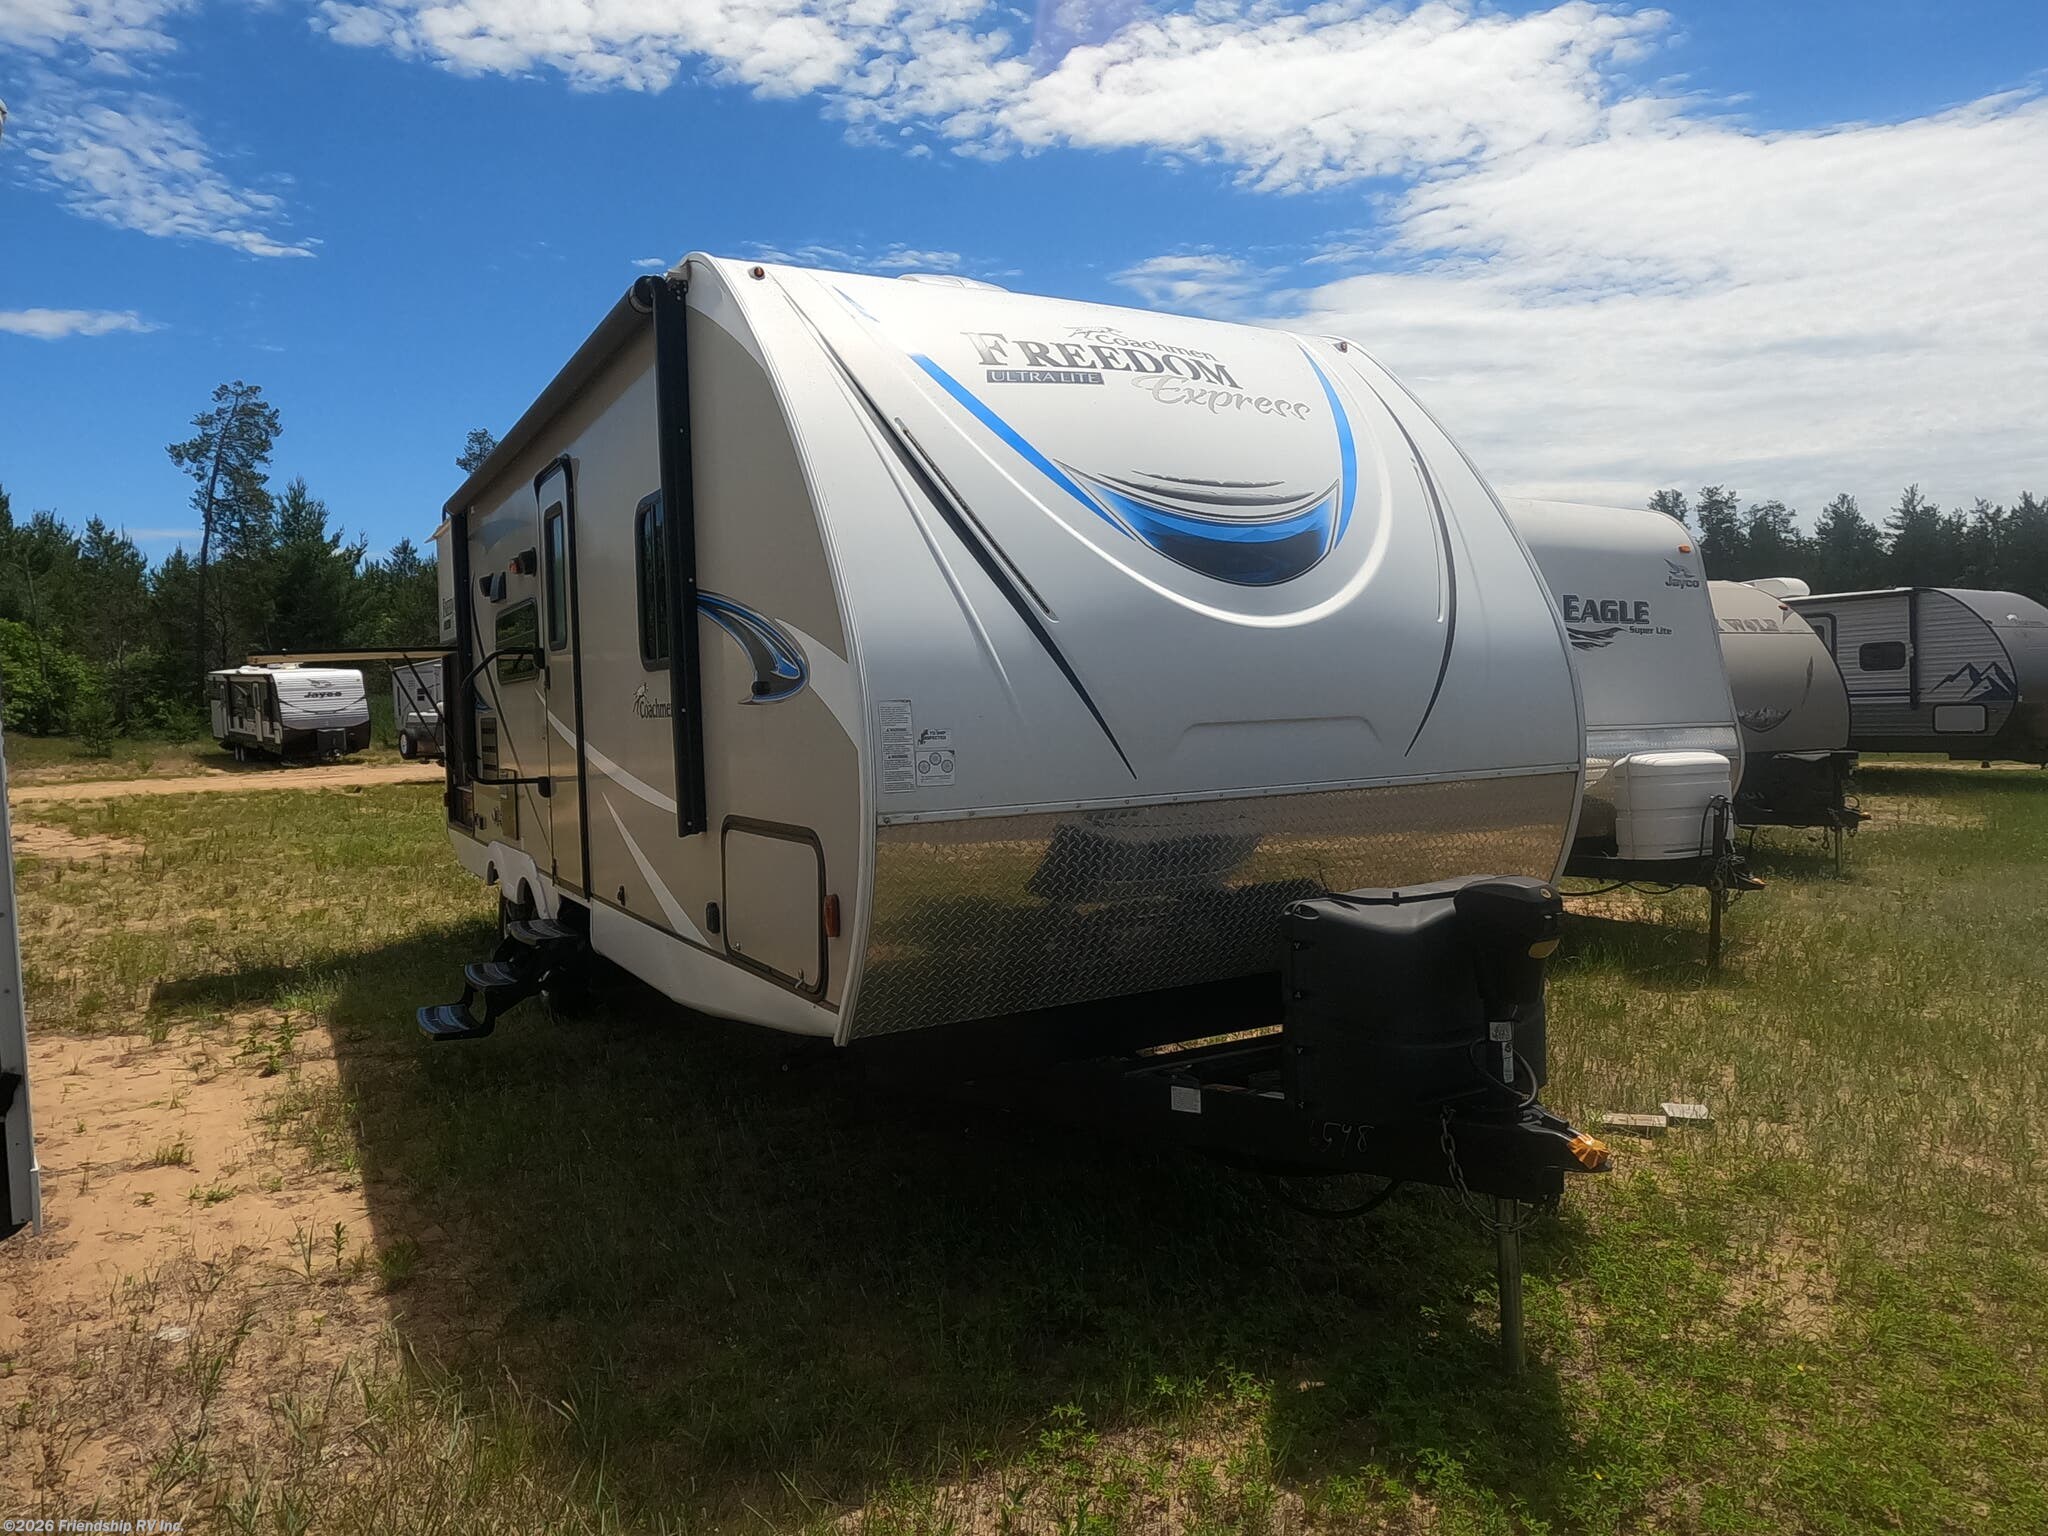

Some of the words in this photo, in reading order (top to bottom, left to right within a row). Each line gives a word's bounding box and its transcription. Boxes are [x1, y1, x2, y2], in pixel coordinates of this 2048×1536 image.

[1096, 334, 1216, 362] Coachmen
[960, 332, 1243, 389] FREEDOM
[991, 371, 1056, 383] ULTRA
[1060, 372, 1100, 384] LITE
[1131, 374, 1311, 420] Express
[1665, 576, 1699, 589] Jayco
[1563, 595, 1649, 624] EAGLE
[1629, 626, 1654, 635] Super
[1656, 626, 1672, 635] Lite
[640, 698, 671, 719] Coachme
